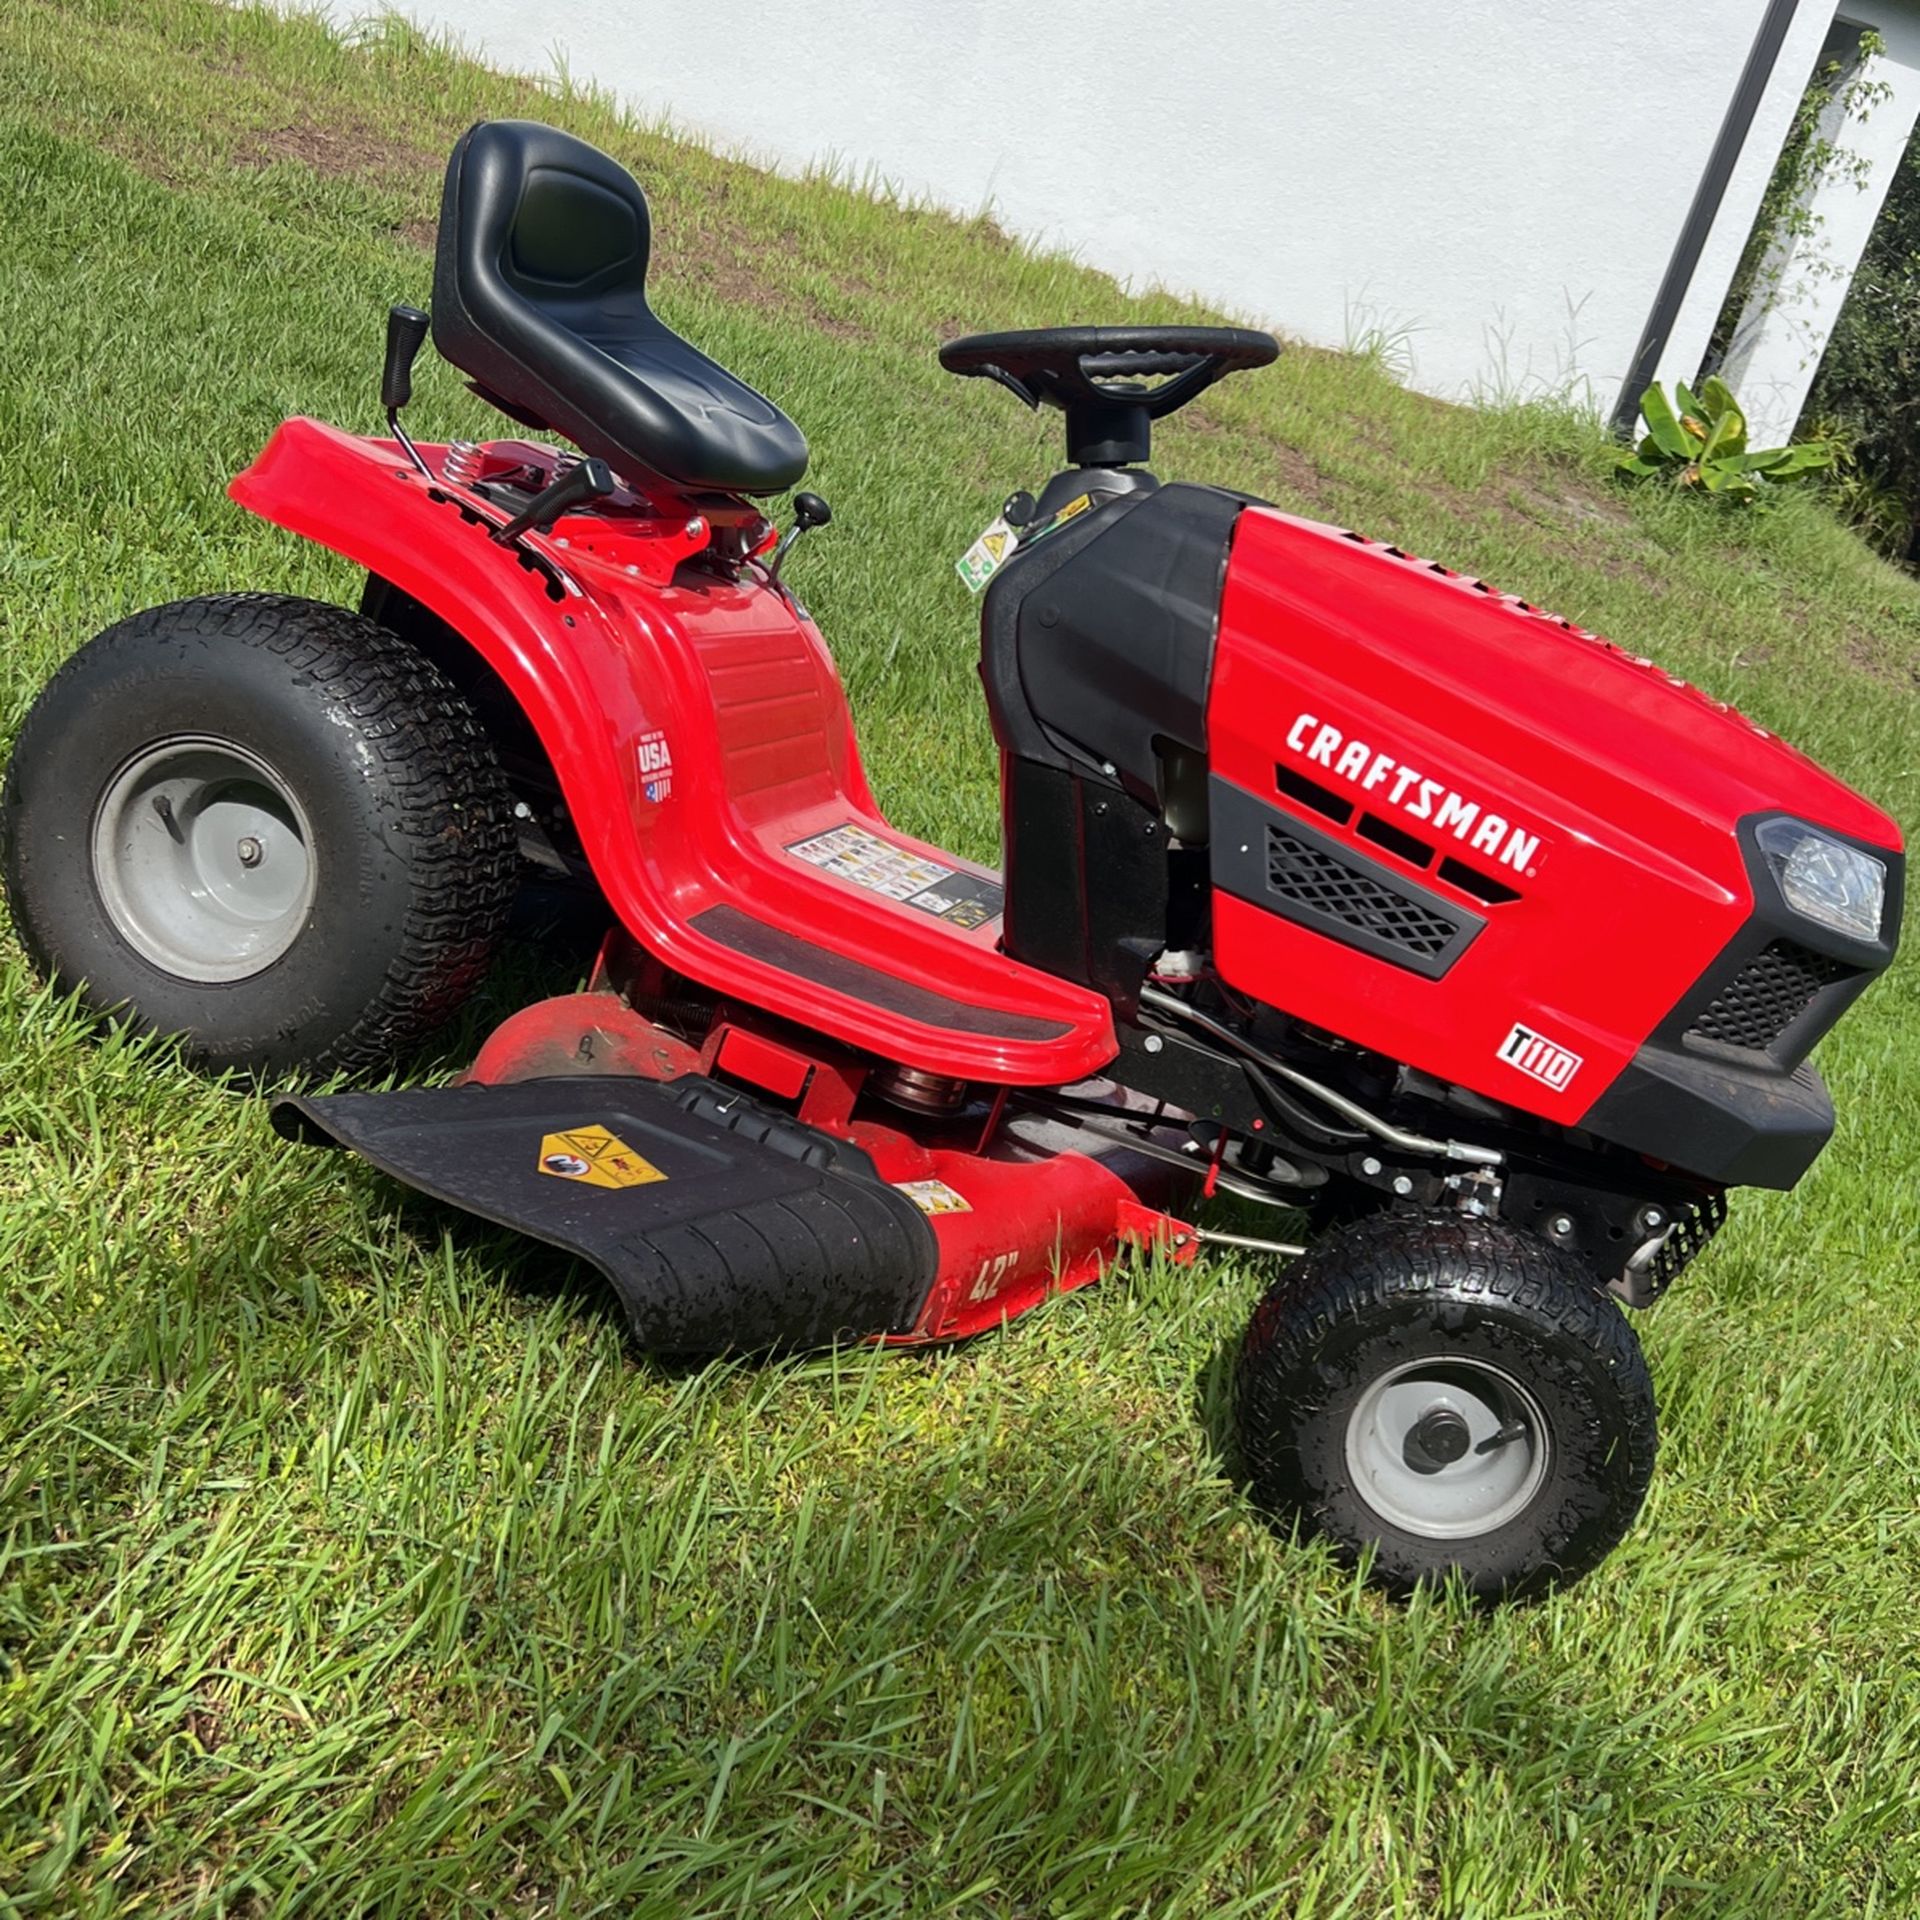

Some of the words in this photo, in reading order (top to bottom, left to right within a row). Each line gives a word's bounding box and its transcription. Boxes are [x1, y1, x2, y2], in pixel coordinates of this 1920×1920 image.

[638, 739, 672, 773] USA
[1286, 713, 1540, 873] CRAFTSMAN
[1505, 1025, 1579, 1088] T110
